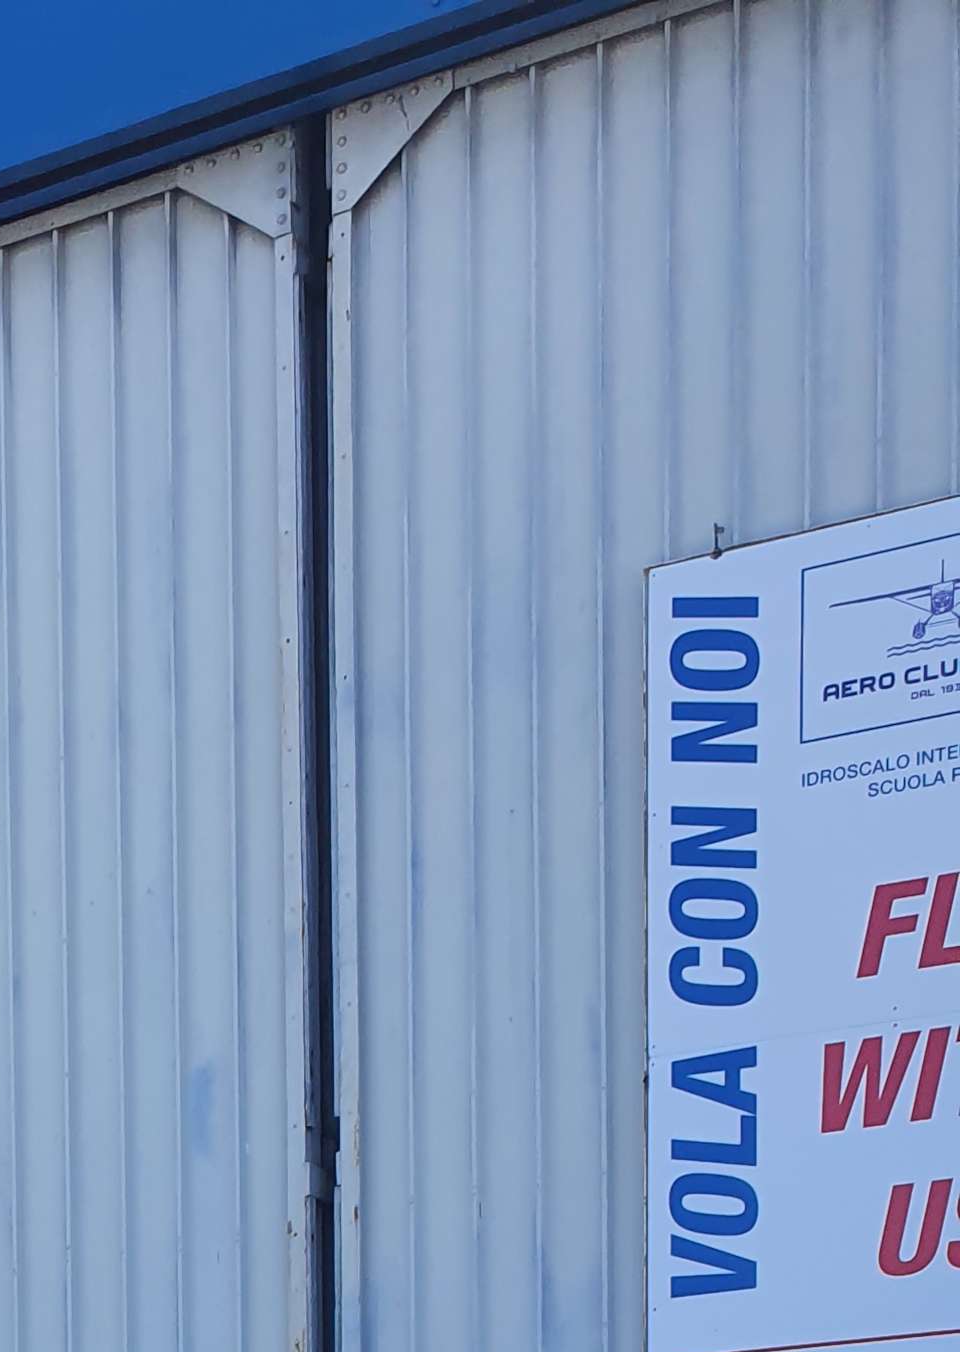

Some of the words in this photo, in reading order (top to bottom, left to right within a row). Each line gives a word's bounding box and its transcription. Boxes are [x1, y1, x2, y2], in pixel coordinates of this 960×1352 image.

[669, 596, 760, 763] NOI
[823, 672, 895, 702] AERO
[904, 658, 959, 685] CLU
[801, 754, 910, 788] IDROSCALO
[868, 770, 945, 798] SCUOLA
[668, 805, 759, 1007] CON
[821, 1023, 960, 1134] WI
[668, 1045, 759, 1298] VOLA
[878, 1178, 960, 1277] U
